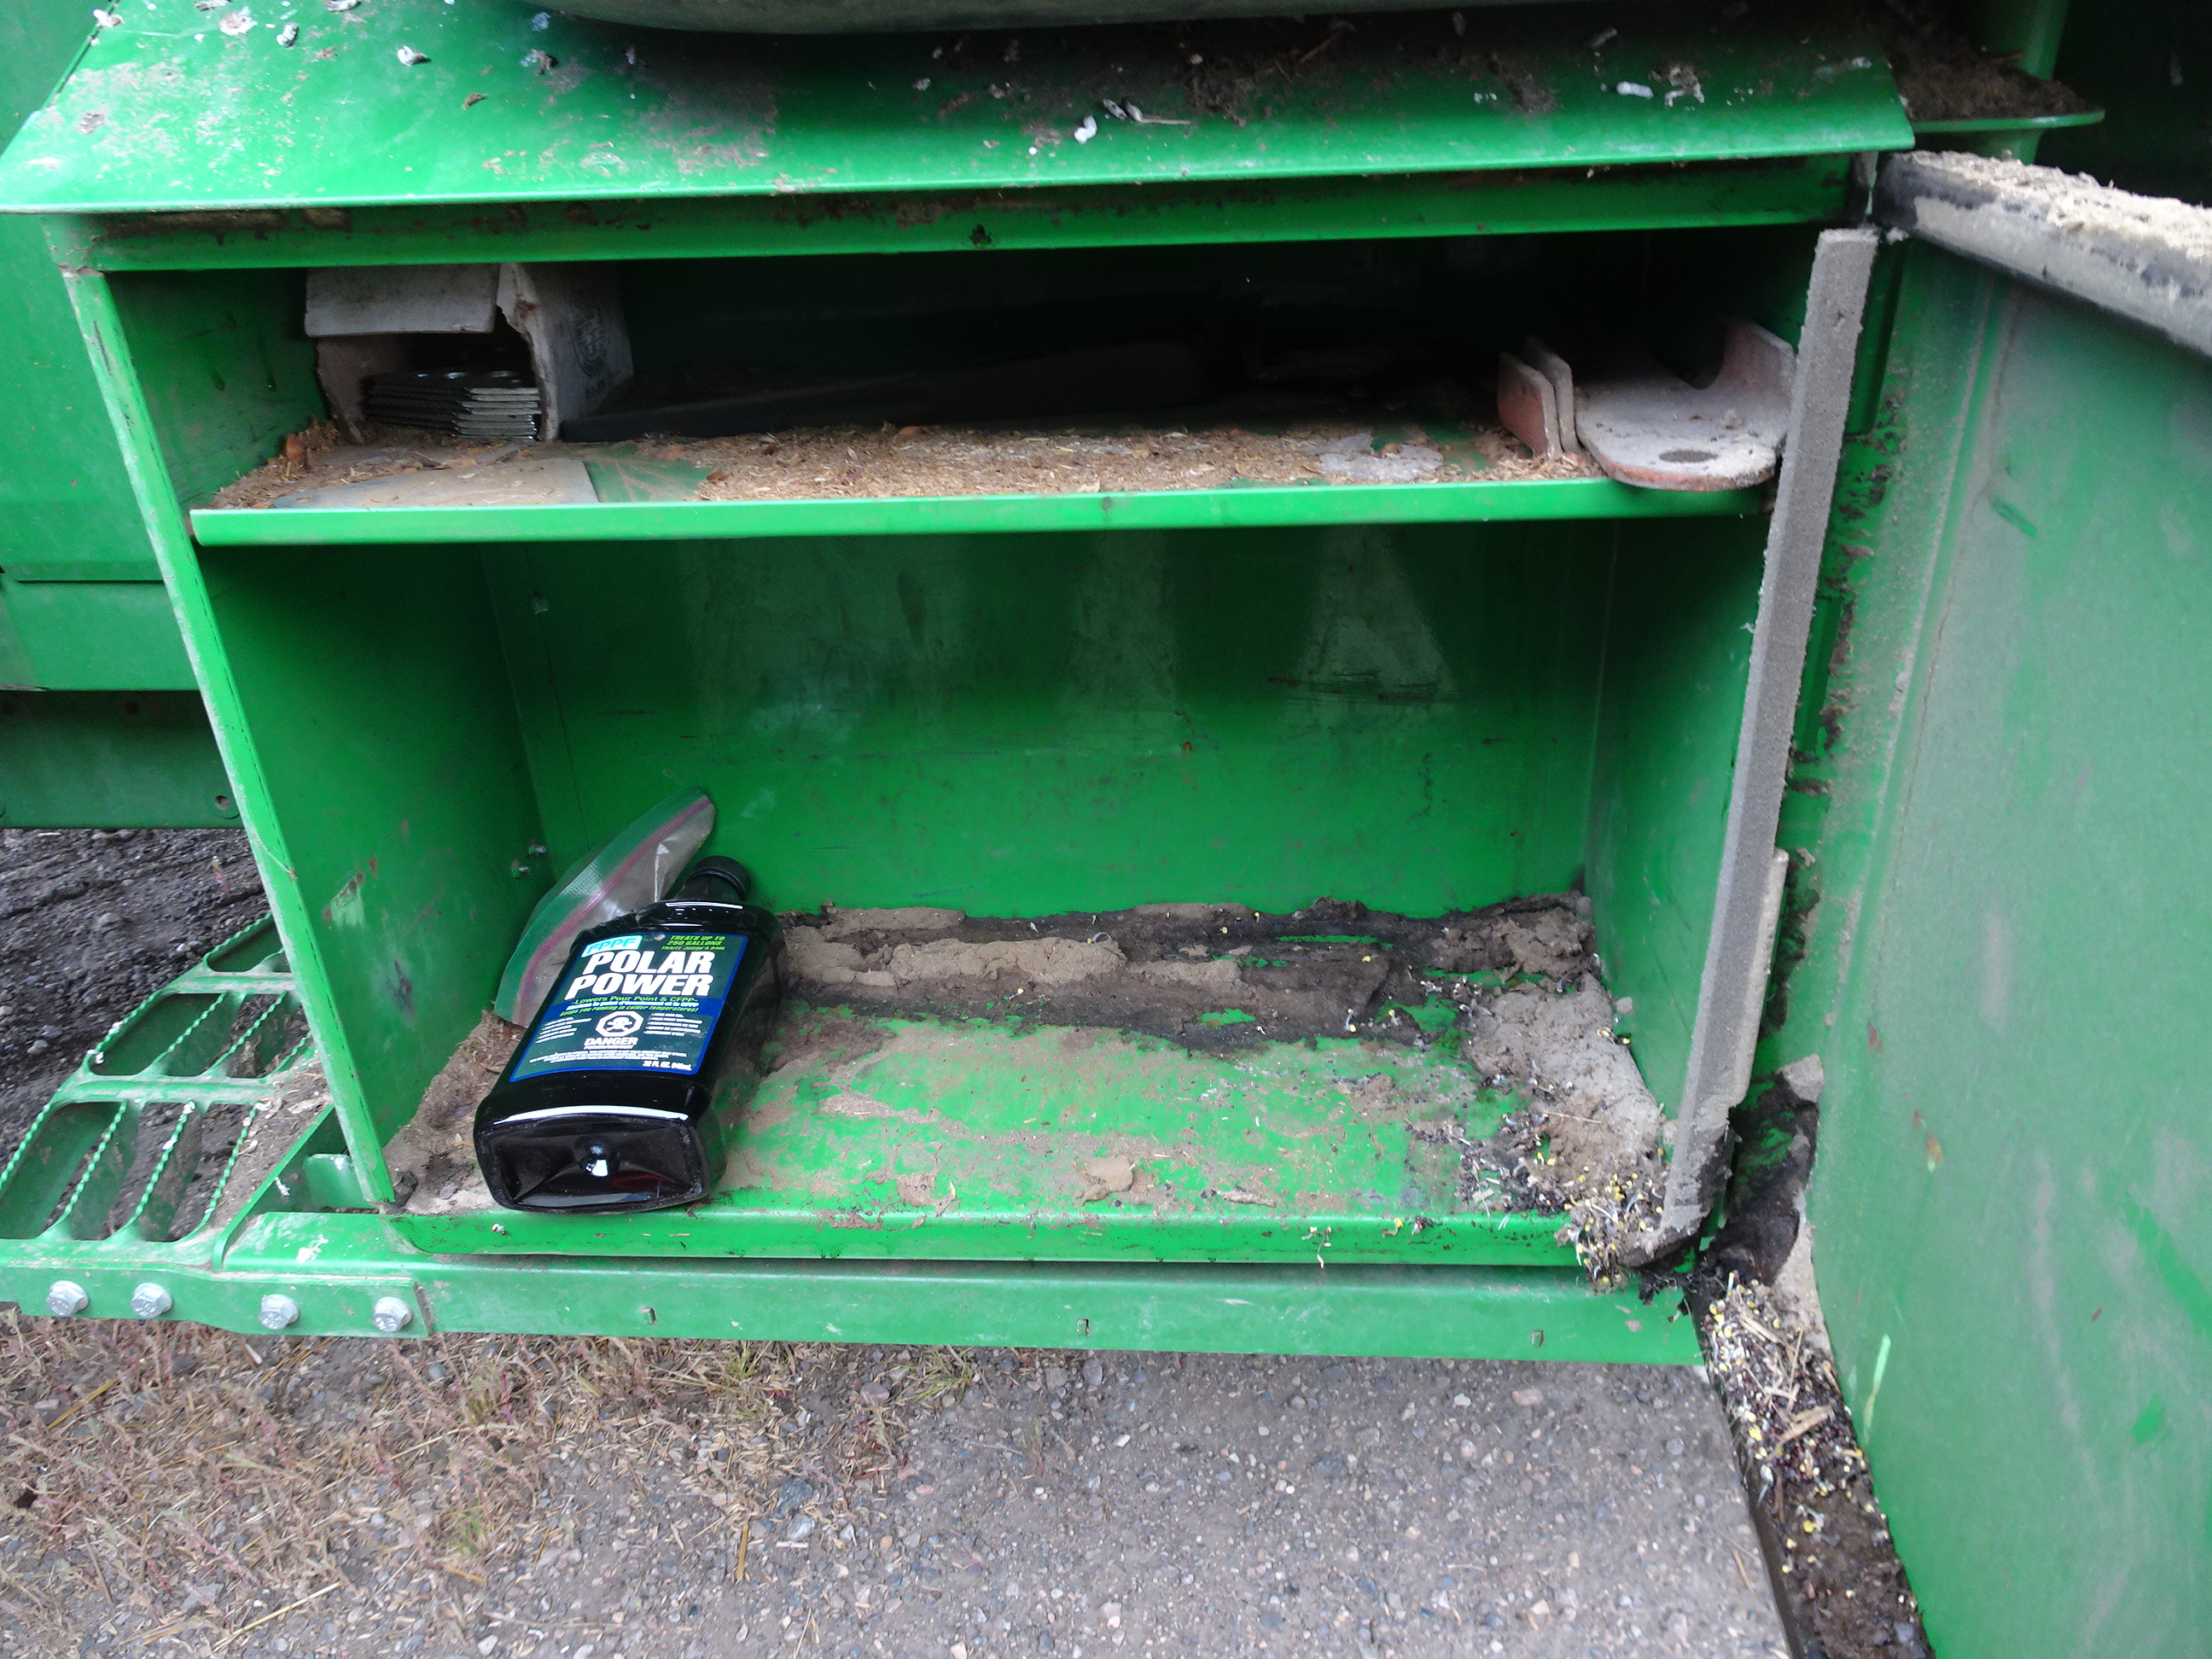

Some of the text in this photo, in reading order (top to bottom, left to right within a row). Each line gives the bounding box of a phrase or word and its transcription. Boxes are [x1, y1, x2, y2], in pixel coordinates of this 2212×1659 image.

[586, 937, 637, 954] FPPF
[582, 950, 716, 975] POLAR
[564, 972, 715, 1000] POWER
[584, 1037, 638, 1046] DANGER
